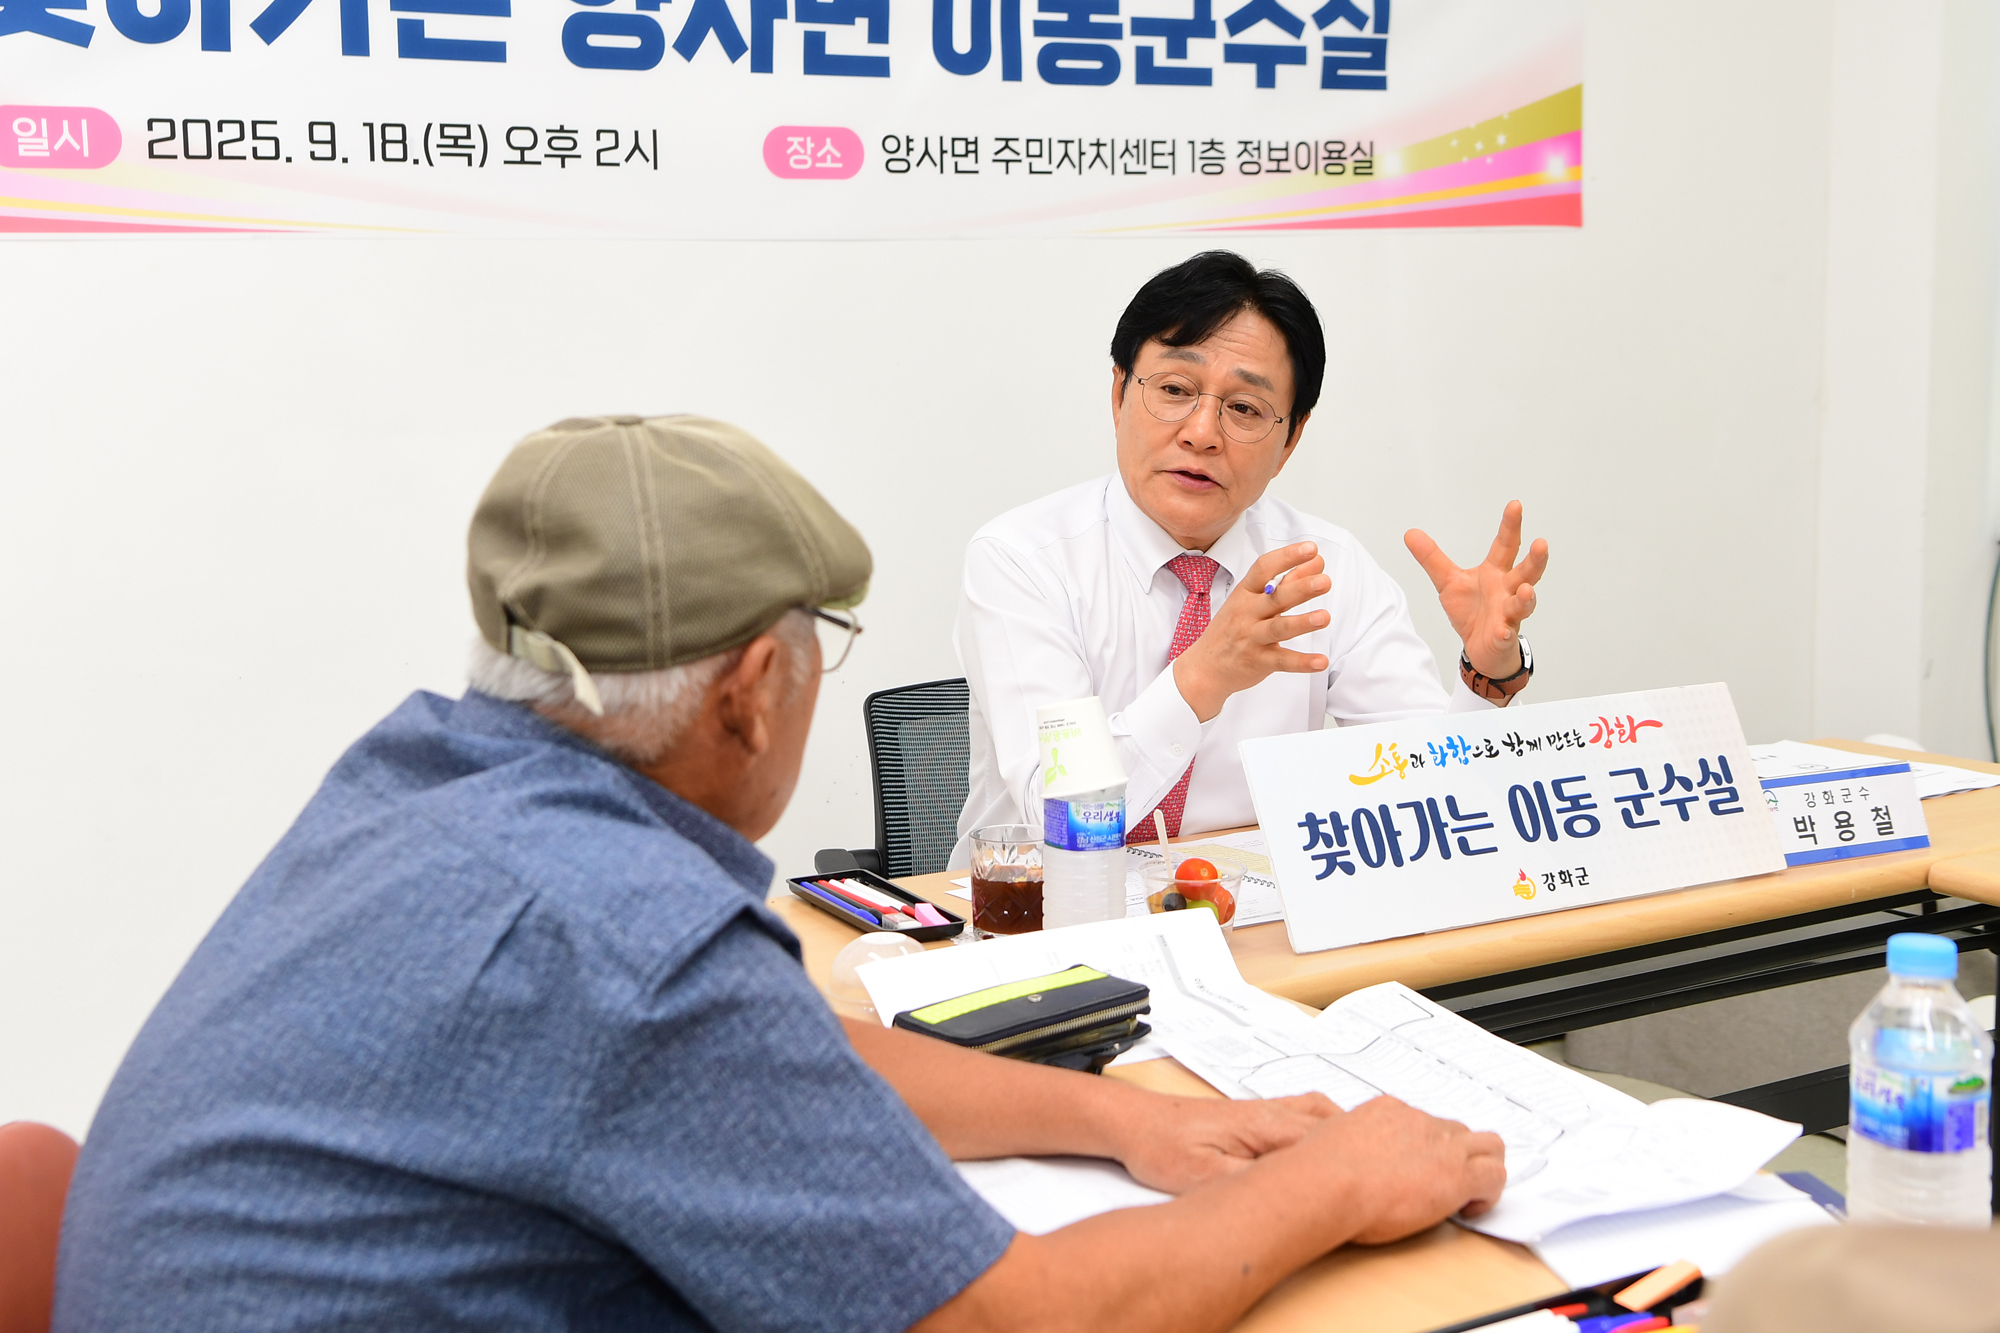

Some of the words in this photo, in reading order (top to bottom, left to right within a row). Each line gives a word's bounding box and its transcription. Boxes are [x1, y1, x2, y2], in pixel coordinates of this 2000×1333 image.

[932, 0, 1391, 91] 이동군수실
[11, 116, 90, 157] 일시
[146, 117, 293, 163] 2025.
[307, 120, 350, 164] 9.
[362, 121, 489, 168] 18.(목)
[503, 124, 582, 169] 오후
[595, 128, 659, 171] 2시
[785, 136, 844, 170] 장소
[881, 134, 980, 175] 양사면
[991, 137, 1176, 176] 주민자치센터
[1187, 137, 1227, 176] 1층
[1235, 139, 1375, 176] 정보이용실
[1501, 731, 1542, 757] 함께
[1546, 728, 1586, 751] 만드는
[1588, 714, 1664, 749] 강화
[1297, 794, 1499, 881] 찾아가는
[1507, 774, 1602, 843] 이동
[1608, 754, 1745, 830] 군수실
[1540, 866, 1591, 893] 강화군
